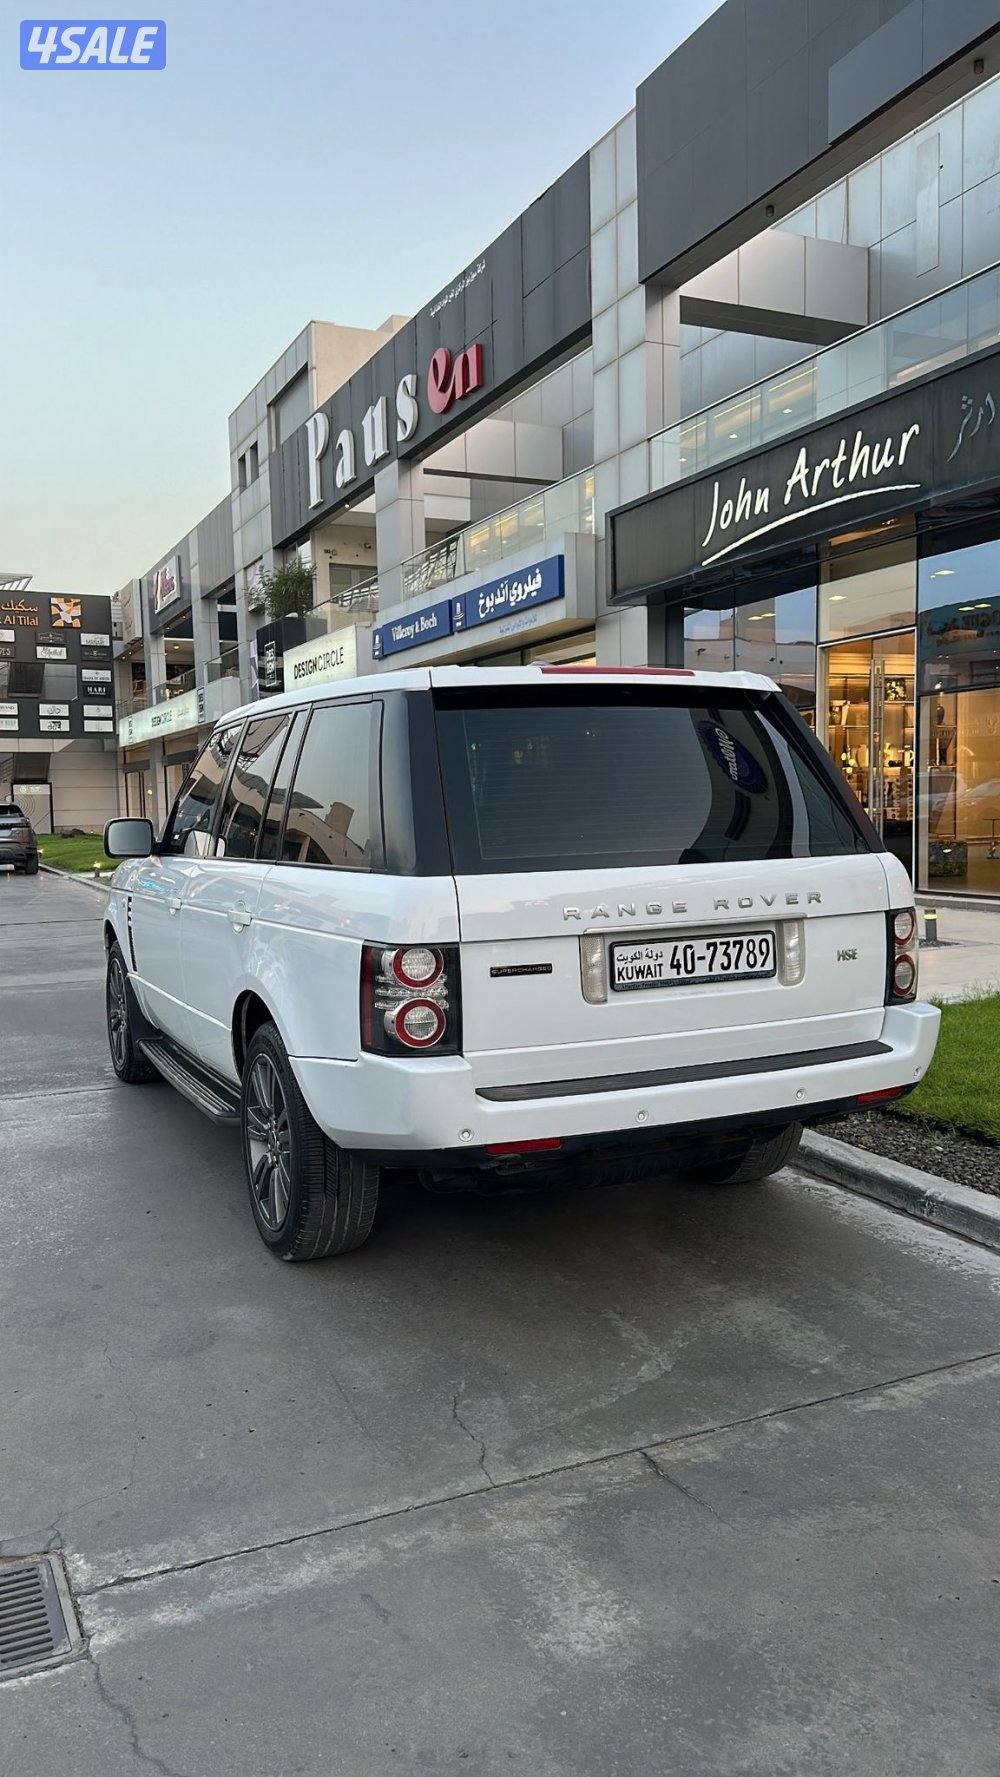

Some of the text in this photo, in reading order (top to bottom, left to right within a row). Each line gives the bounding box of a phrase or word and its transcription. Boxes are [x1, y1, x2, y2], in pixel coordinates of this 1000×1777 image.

[305, 343, 483, 509] Pausen
[701, 424, 920, 547] John Arthur
[3, 615, 39, 626] Al Tilal
[562, 891, 822, 921] RANGE ROVER
[616, 947, 664, 965] دولة الكويت
[669, 937, 770, 976] 40-73789
[837, 949, 858, 961] HSE
[617, 963, 664, 982] KUWAIT
